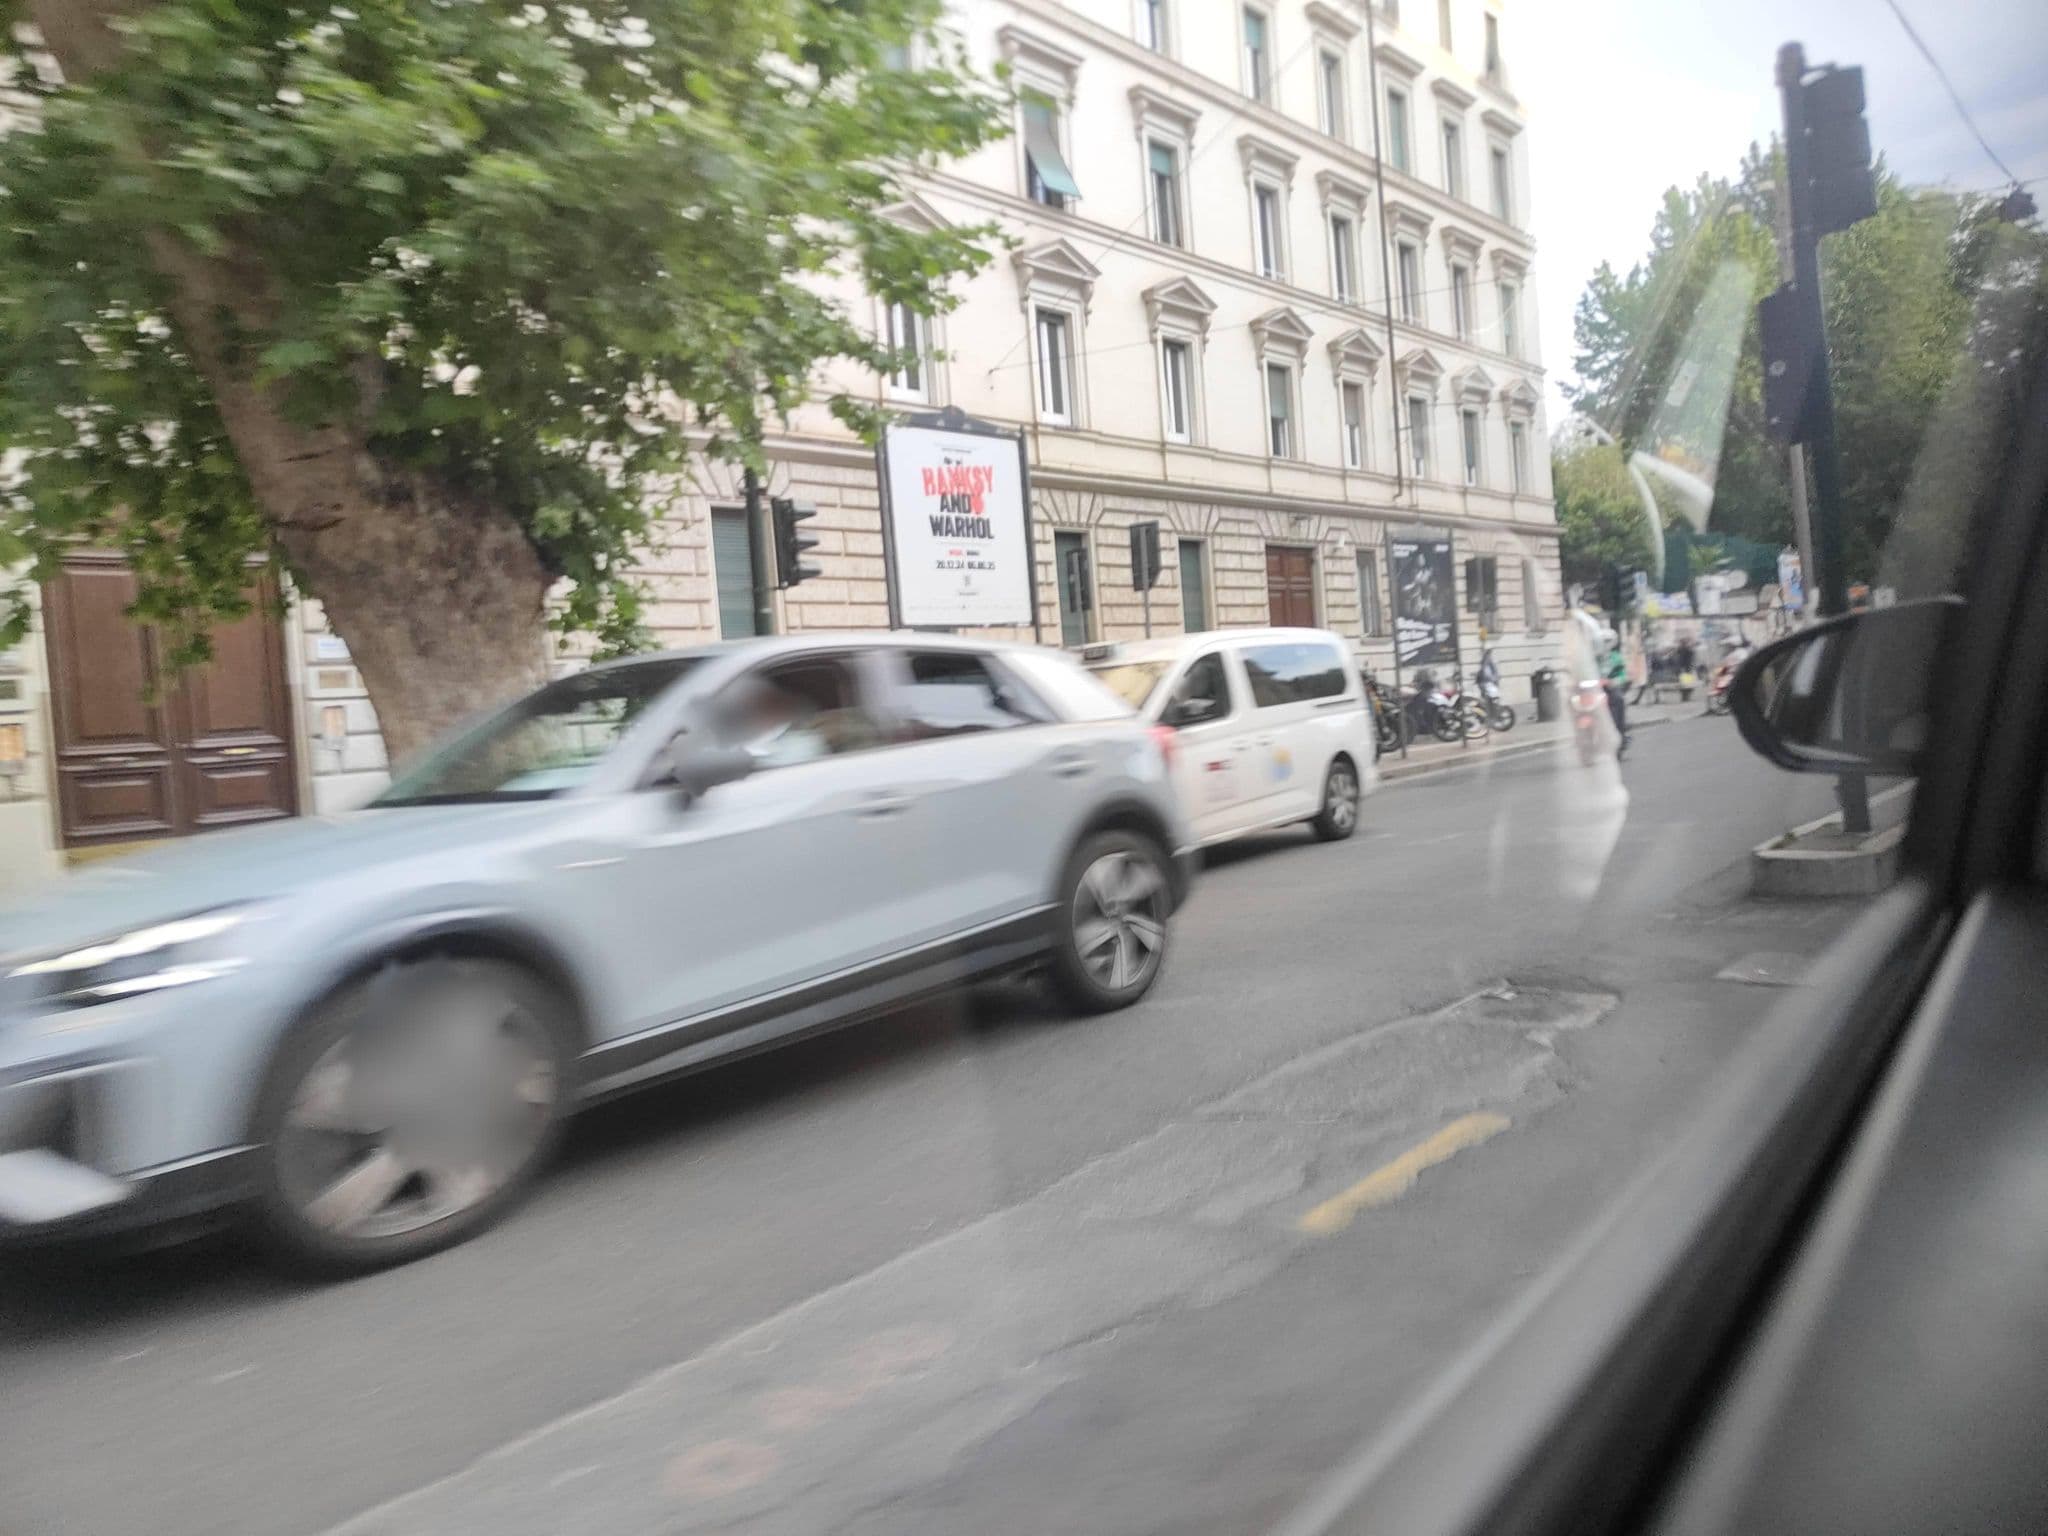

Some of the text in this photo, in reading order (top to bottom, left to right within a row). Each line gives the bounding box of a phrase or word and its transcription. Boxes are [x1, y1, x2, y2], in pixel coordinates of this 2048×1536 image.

[922, 465, 993, 496] BANKSY
[940, 492, 972, 513] AND
[929, 514, 995, 539] WARHOL
